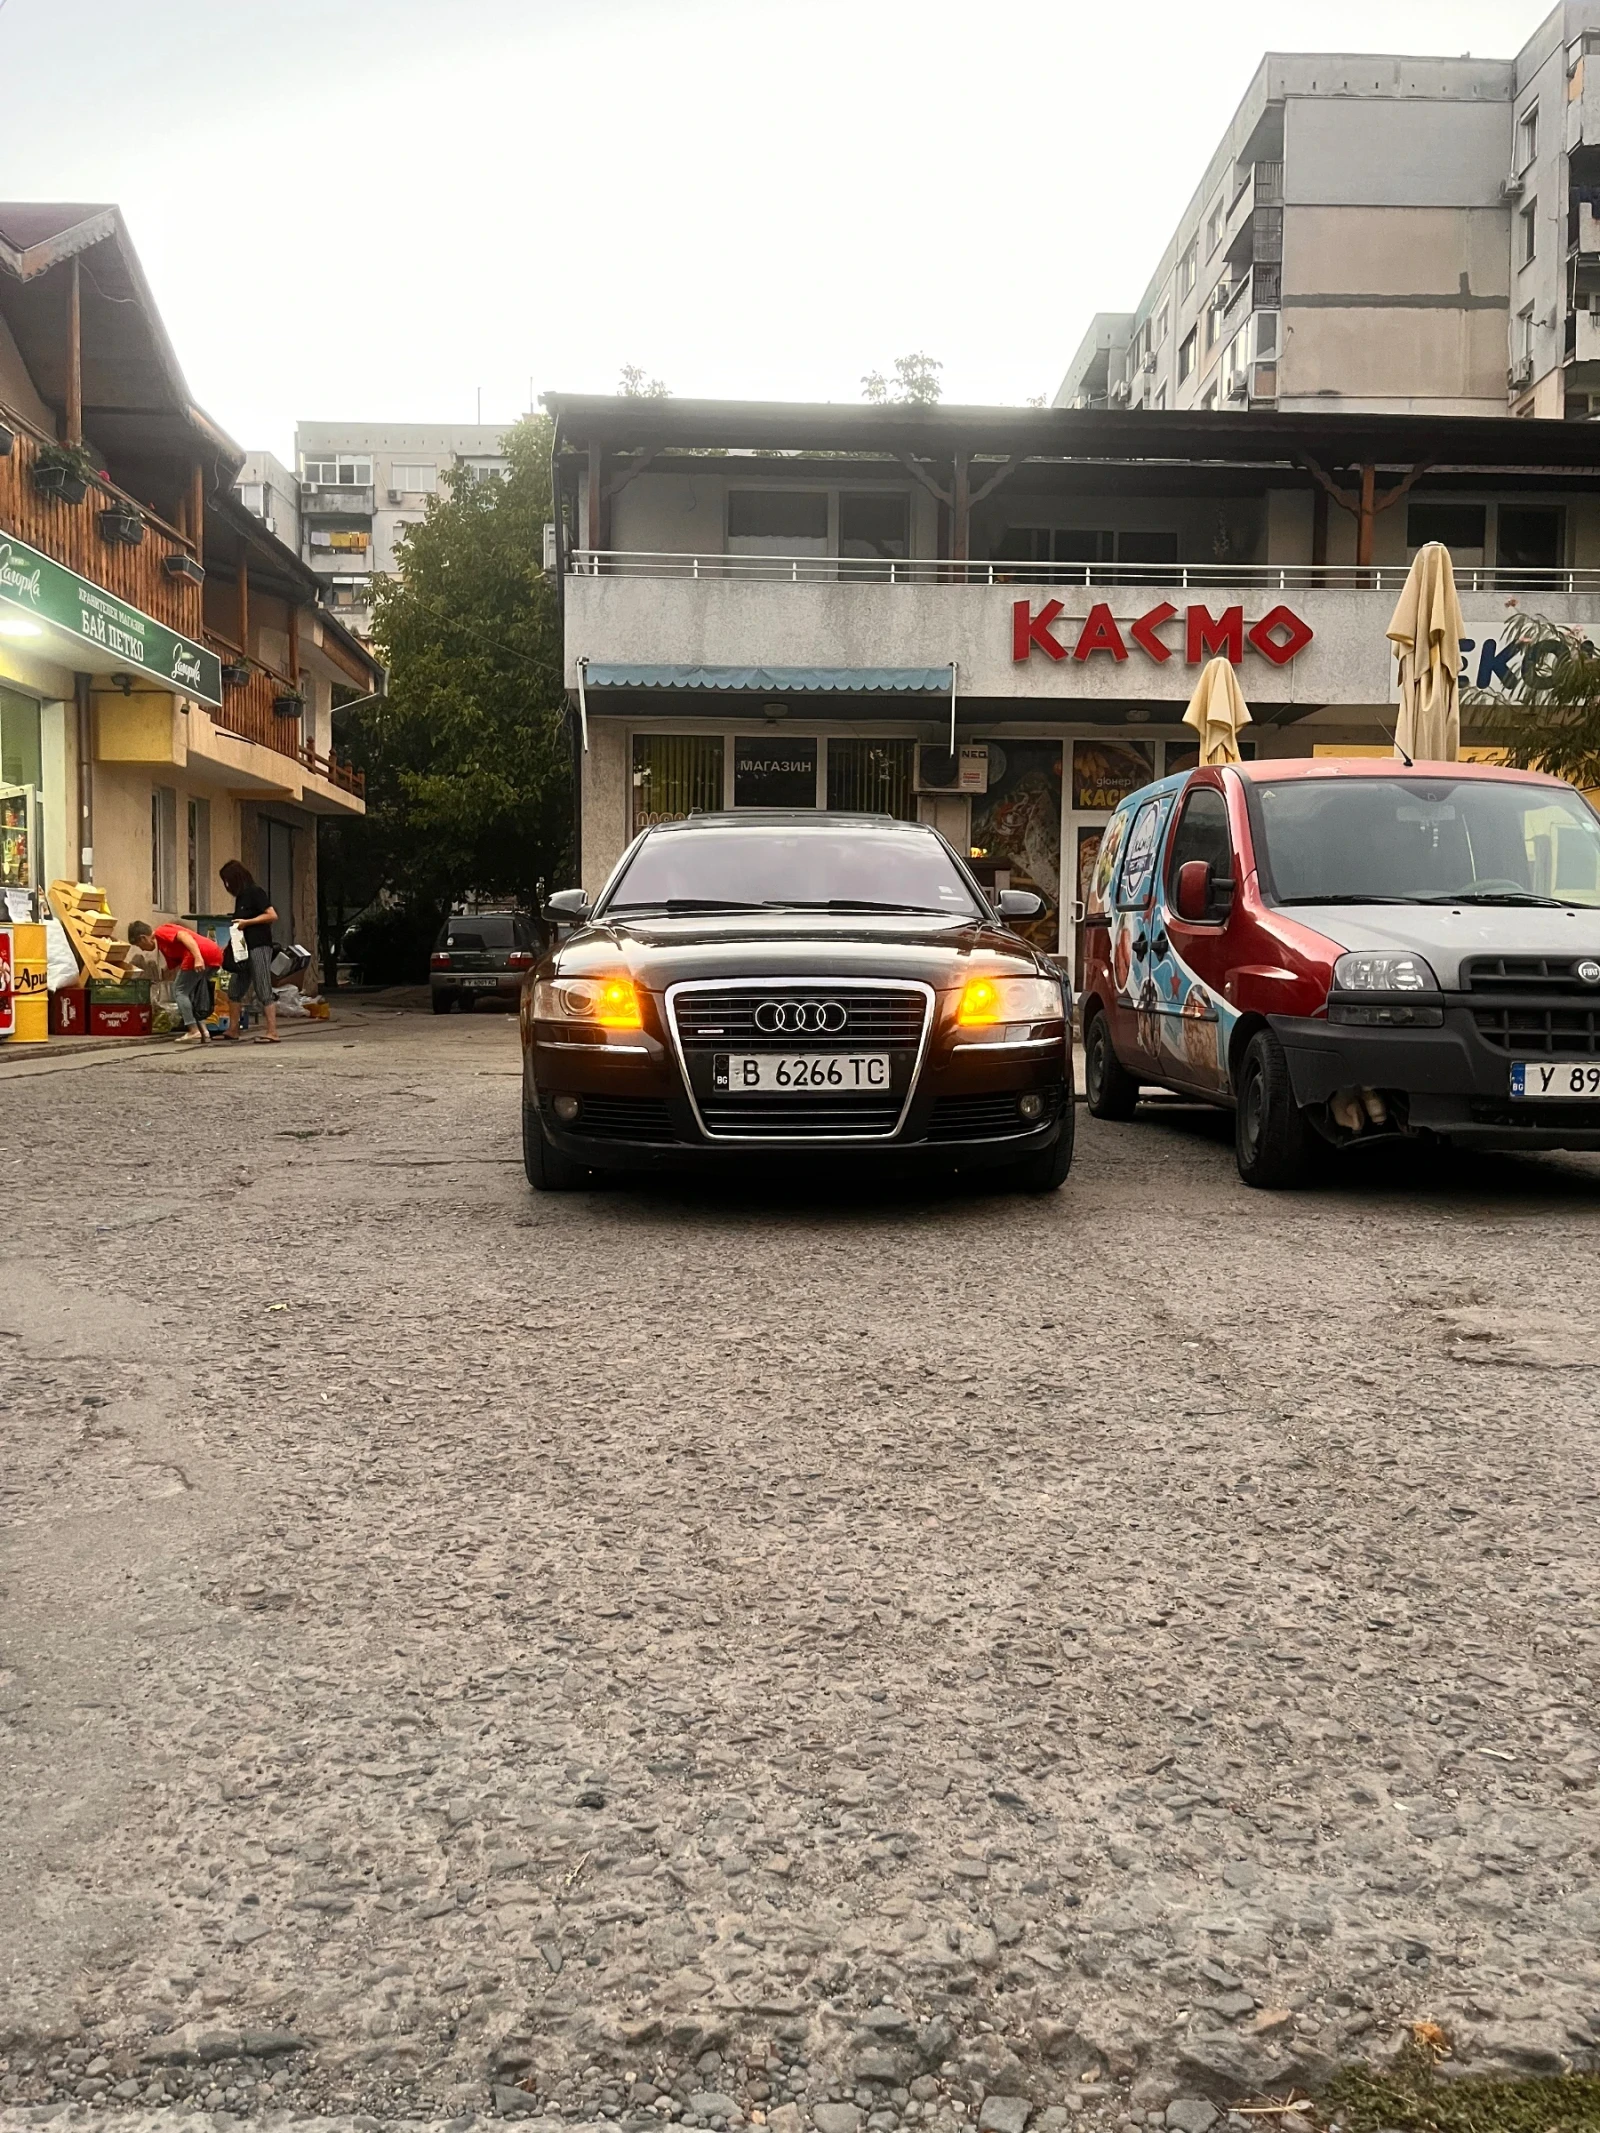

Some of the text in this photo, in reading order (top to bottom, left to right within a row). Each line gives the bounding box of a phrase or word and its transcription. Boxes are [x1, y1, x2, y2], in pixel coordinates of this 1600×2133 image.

[79, 587, 145, 635] ХРАНИТЕЛЕН МАГАЗИН
[82, 610, 144, 661] БАЙ ПЕТКО
[1012, 599, 1314, 665] КАСМО
[740, 760, 812, 772] МАГАЗИН
[1582, 968, 1598, 976] FIAT
[717, 1075, 728, 1085] BG
[776, 1059, 843, 1086] 6266
[1570, 1068, 1600, 1092] 89
[1512, 1083, 1524, 1091] BG
